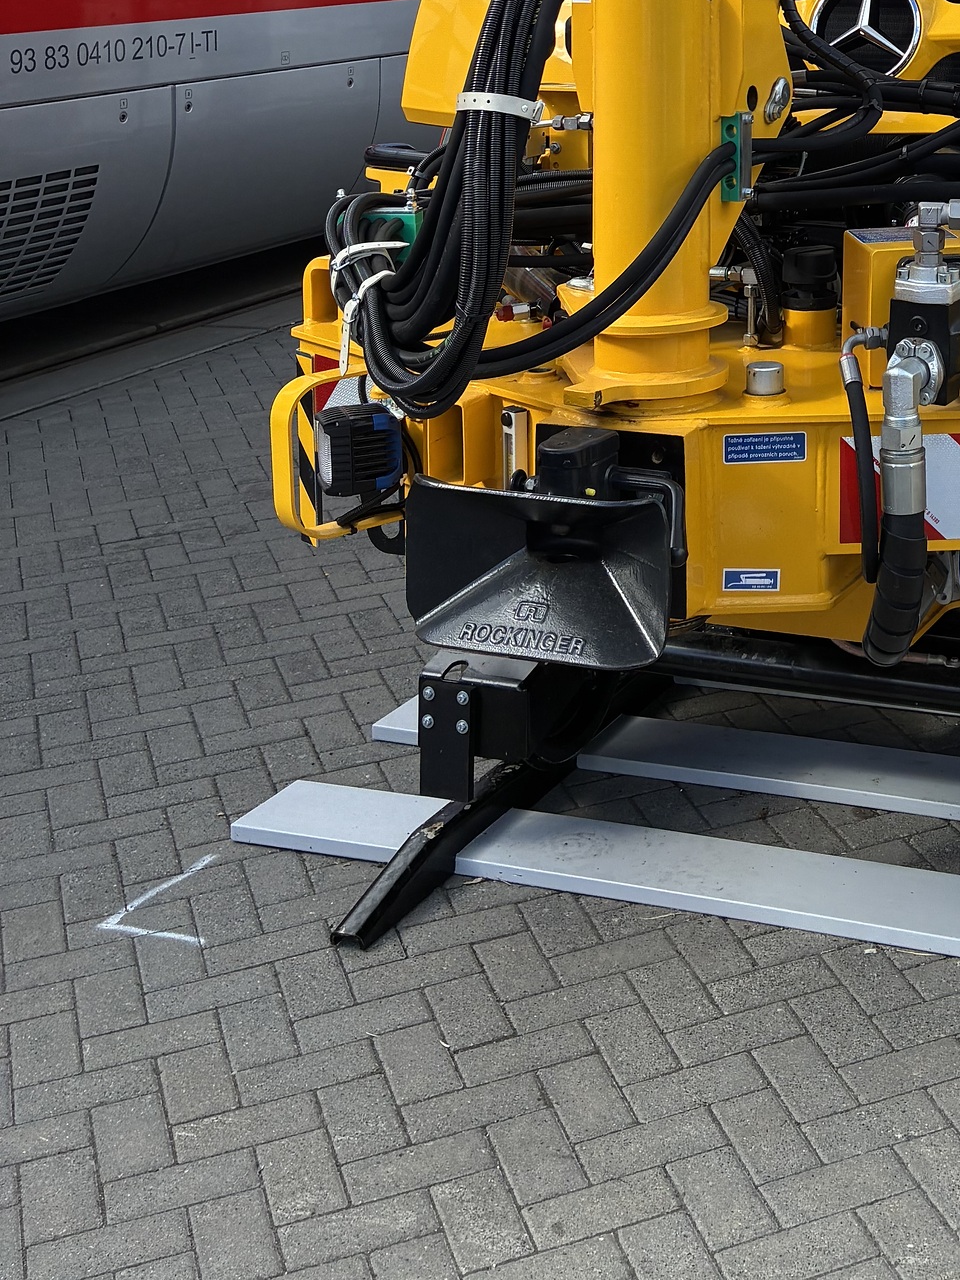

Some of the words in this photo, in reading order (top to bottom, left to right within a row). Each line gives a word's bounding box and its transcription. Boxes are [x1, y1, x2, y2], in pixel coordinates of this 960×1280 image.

[10, 48, 37, 74] 93
[44, 45, 70, 70] 83
[77, 39, 126, 66] 0410
[458, 621, 586, 656] ROCKINGER
